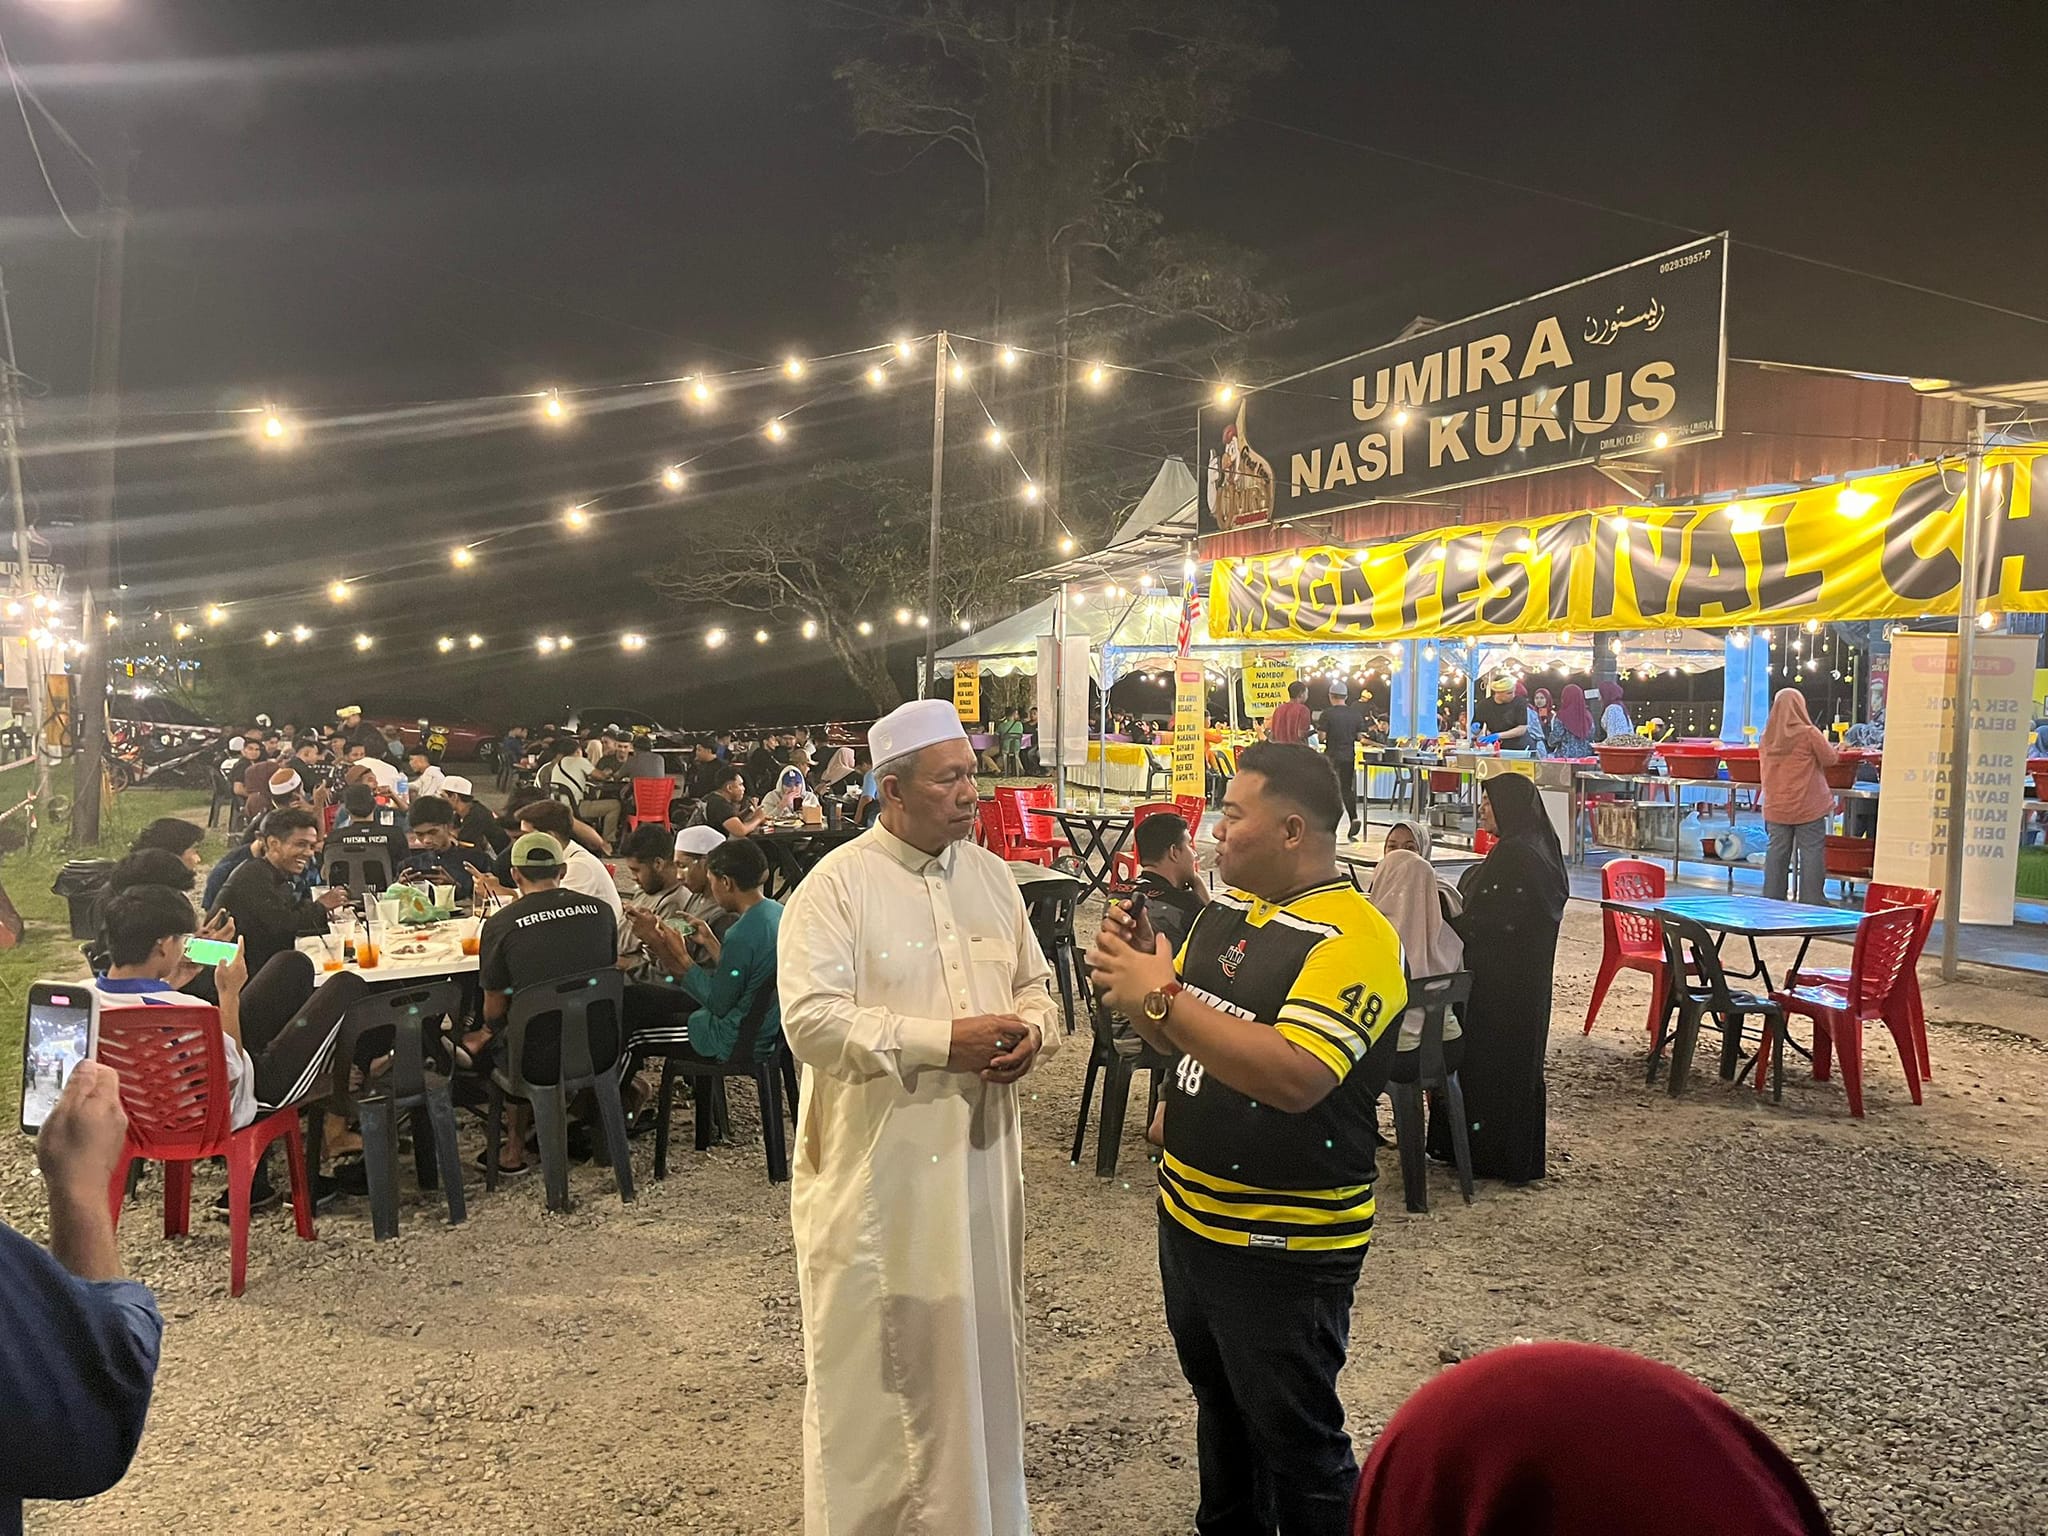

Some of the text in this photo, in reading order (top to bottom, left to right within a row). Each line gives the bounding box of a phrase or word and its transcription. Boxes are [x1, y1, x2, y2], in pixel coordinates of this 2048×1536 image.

[1352, 316, 1574, 421] UMIRA
[1290, 361, 1676, 498] NASI KUKUS
[1227, 552, 1376, 634] MEGA
[1400, 502, 1823, 630] FESTIVAL
[515, 904, 599, 928] TERENGGANU
[1336, 981, 1384, 1030] 48
[1175, 1053, 1204, 1097] 48
